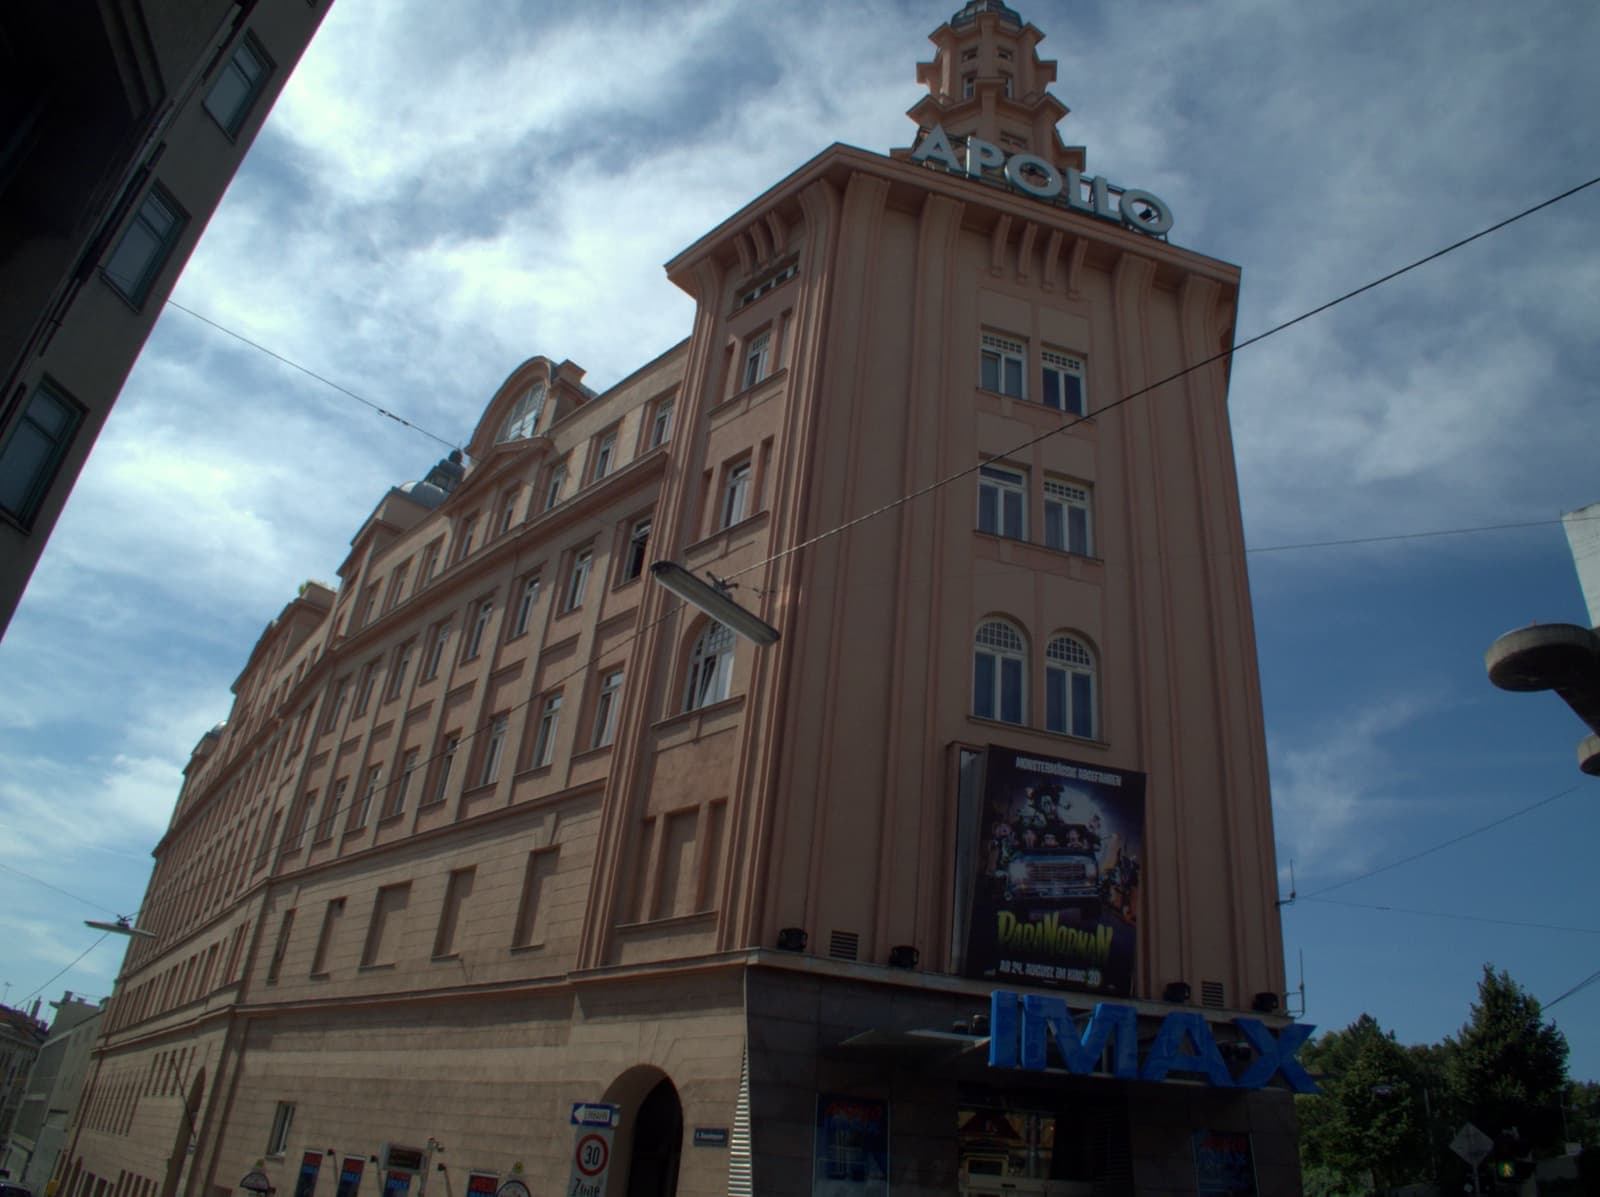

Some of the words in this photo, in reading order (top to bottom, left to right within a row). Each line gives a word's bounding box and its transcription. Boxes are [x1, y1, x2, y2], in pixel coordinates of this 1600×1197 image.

[912, 123, 1174, 236] APOLLO
[988, 990, 1322, 1095] IMAX
[584, 1145, 600, 1166] 30
